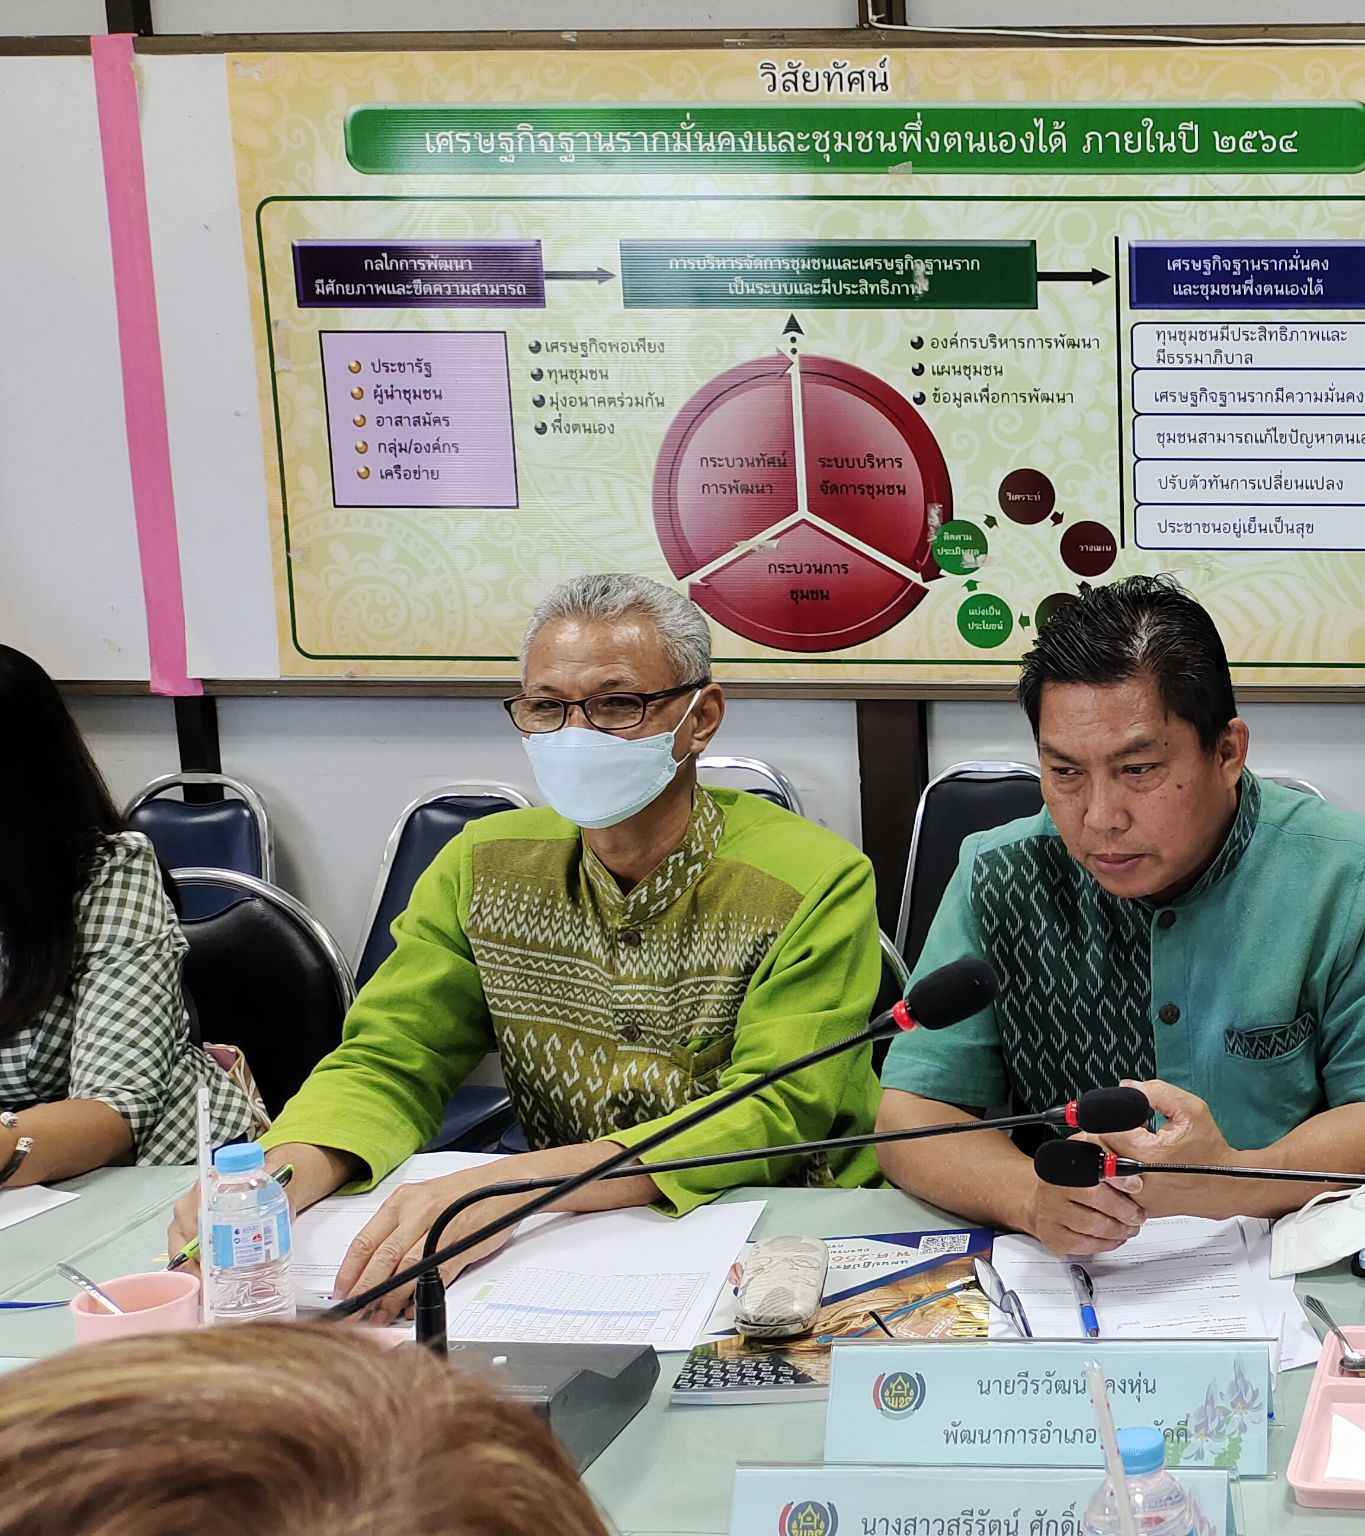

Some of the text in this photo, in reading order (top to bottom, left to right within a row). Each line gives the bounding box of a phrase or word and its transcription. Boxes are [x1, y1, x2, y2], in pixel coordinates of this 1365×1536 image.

[760, 57, 889, 96] วิสัยทัศน์
[425, 112, 1299, 164] เศรษฐกิจฐานรากมั่นคงและชุมชนพึ่งตนเองได้ ภายในปี ๒๕๖๔
[364, 253, 473, 271] กลไกการพัฒนา
[1167, 249, 1329, 275] เศรษฐกิจฐานรากมั่นคง
[1173, 276, 1324, 300] และชุมชนพึ่งตนเองได้
[930, 333, 1101, 351] องค์กรบริหารการพัฒนา
[1155, 325, 1348, 346] ทุนชุมชนมีประสิทธิภาพและ
[544, 338, 666, 359] เศรษฐกิจพอเพียง
[1155, 348, 1254, 366] มีธรรมาภิบาล
[370, 358, 433, 379] ประชารัฐ
[547, 366, 610, 385] ทุนชุมชน
[930, 362, 1004, 380] แผนชุมชน
[373, 384, 443, 405] ผู้นำชุมชน
[549, 392, 666, 411] มุ่งอนาคตร่วมกัน
[931, 386, 1075, 408] ข้อมูลเพื่อการพัฒนา
[1153, 382, 1365, 408] เศรษฐกิจฐานรากมีความมั่นคง
[376, 412, 450, 428] อาสาสมัคร
[550, 416, 616, 436] พึ่งตนเอง
[378, 437, 460, 456] กลุ่ม/องค์กร
[700, 452, 788, 470] กระบวนทัศน์
[818, 452, 903, 470] ระบบบริหาร
[379, 465, 440, 481] เครือข่าย
[1157, 470, 1345, 492] ปรับตัวทันการเปลี่ยนแปลง
[701, 479, 774, 496] การพัฒนา
[819, 480, 907, 498] จัดการชุมชน
[1157, 514, 1315, 540] ประชาชนอยู่เย็นเป็นสุข
[768, 561, 850, 578] กระบวนการ
[789, 587, 831, 604] ชุมชน
[976, 1370, 1087, 1397] นายวีรวัฒน์
